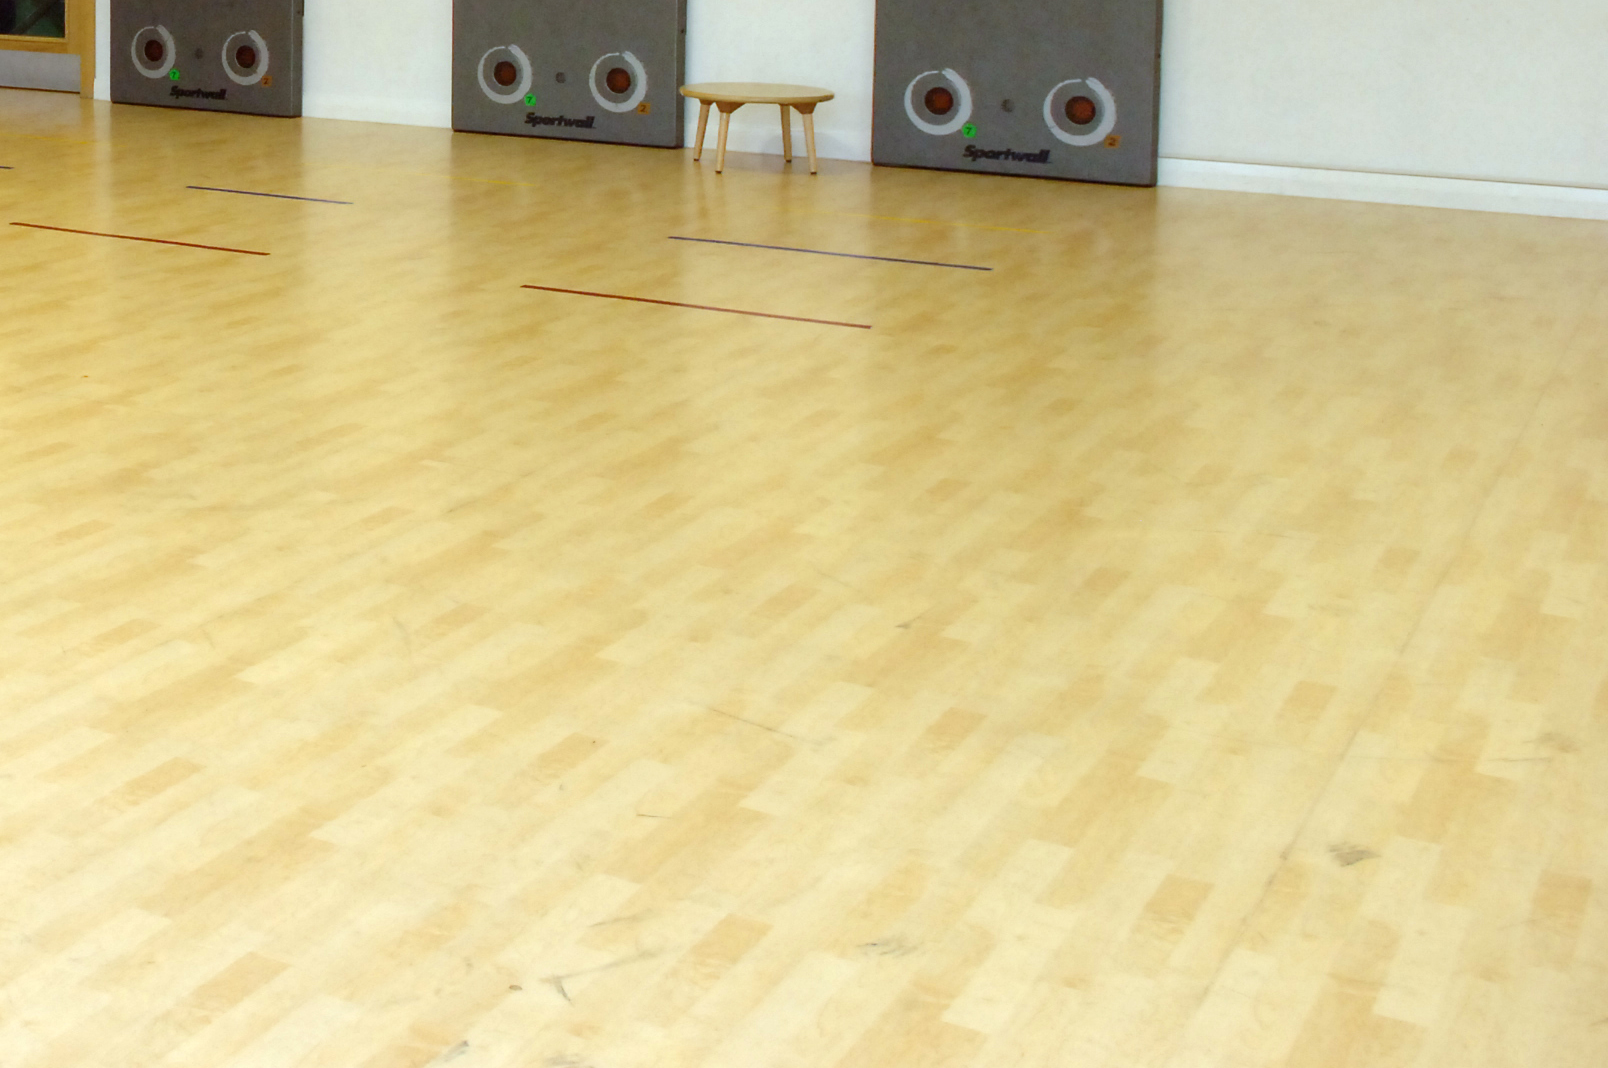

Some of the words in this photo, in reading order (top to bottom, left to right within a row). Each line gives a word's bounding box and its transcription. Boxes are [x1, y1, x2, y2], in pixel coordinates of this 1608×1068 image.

[169, 85, 227, 100] Sportwall
[527, 96, 533, 104] 7
[524, 112, 595, 129] Sportwall
[966, 127, 972, 135] 7
[1108, 138, 1116, 146] 2
[962, 144, 1051, 164] Sportwall
